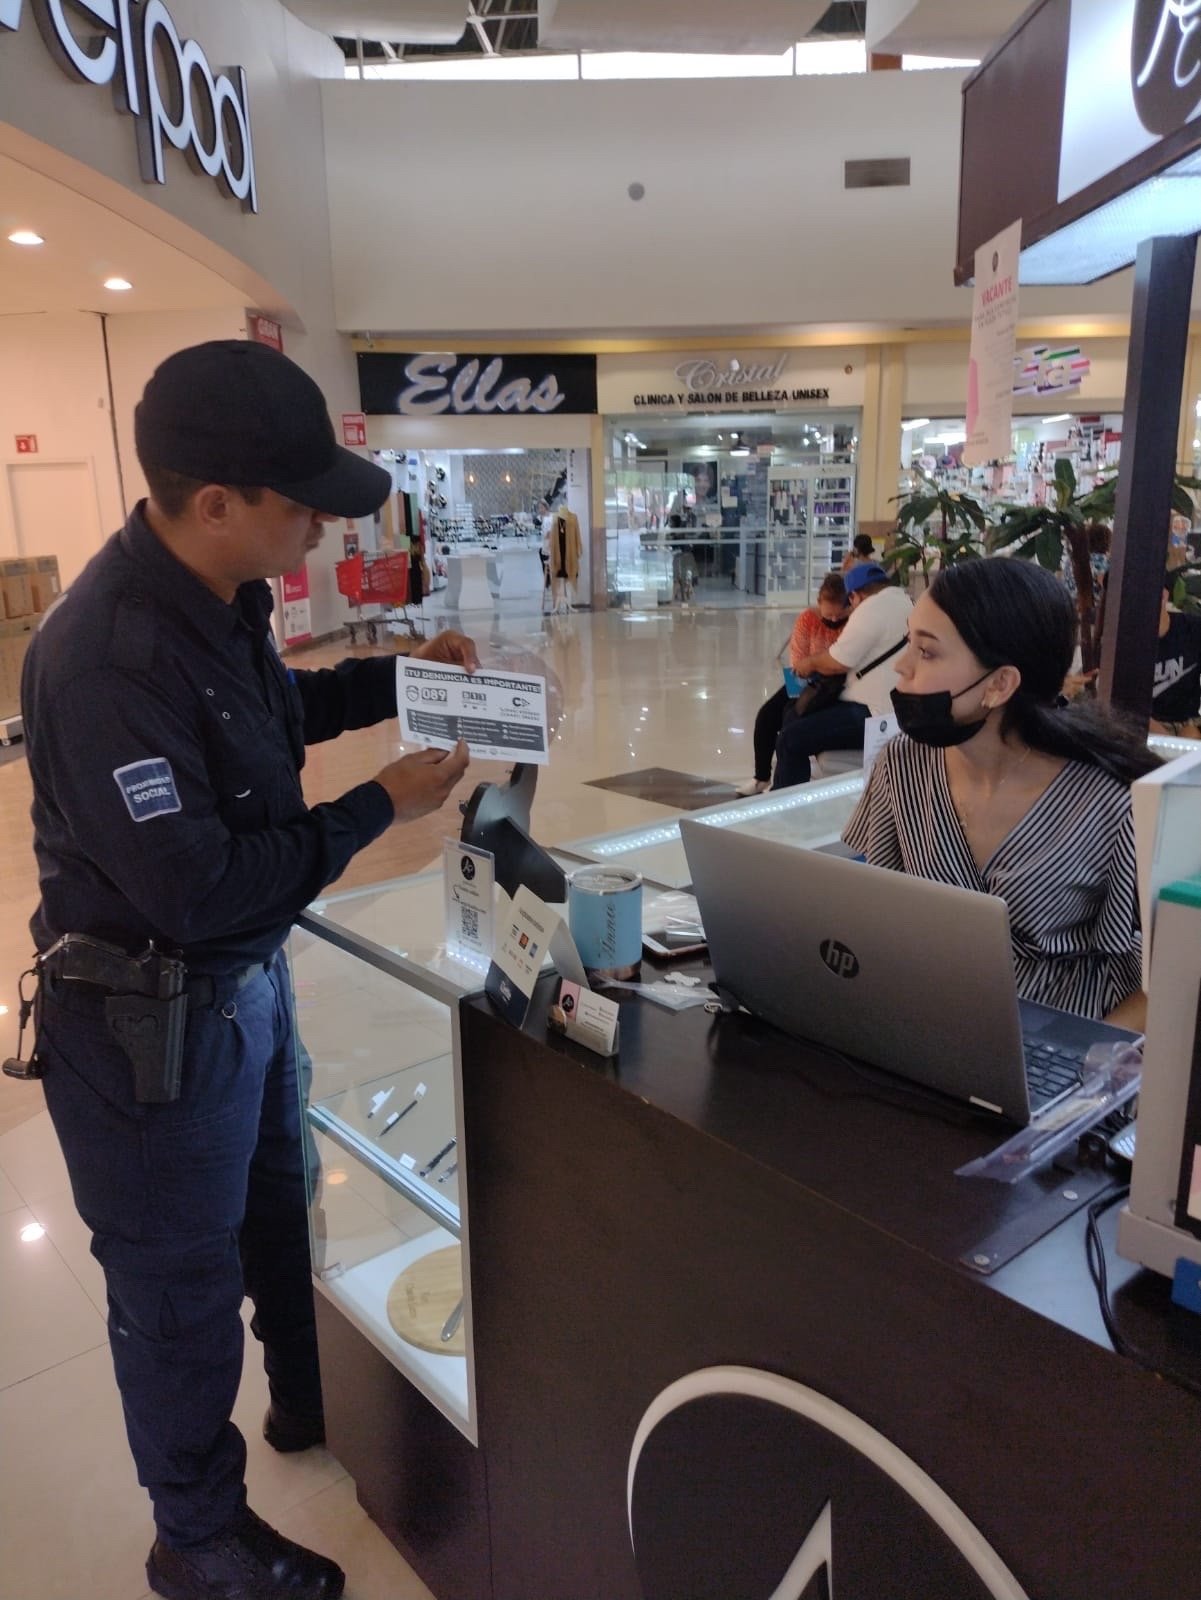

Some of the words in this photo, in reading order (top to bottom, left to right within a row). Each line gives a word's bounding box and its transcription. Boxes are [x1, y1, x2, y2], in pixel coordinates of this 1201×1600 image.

[0, 0, 258, 214] erpool
[981, 276, 1012, 306] VACANTE
[398, 352, 566, 415] Ellas
[634, 393, 675, 406] CLINICA
[677, 393, 685, 404] Y
[687, 392, 722, 404] SALON
[725, 391, 739, 403] DE
[742, 389, 788, 403] BELLEZA
[792, 387, 830, 400] UNISEX
[422, 671, 469, 682] DENUNCIA
[422, 688, 447, 700] 089
[133, 787, 171, 803] SOCIAL
[826, 939, 856, 979] hp
